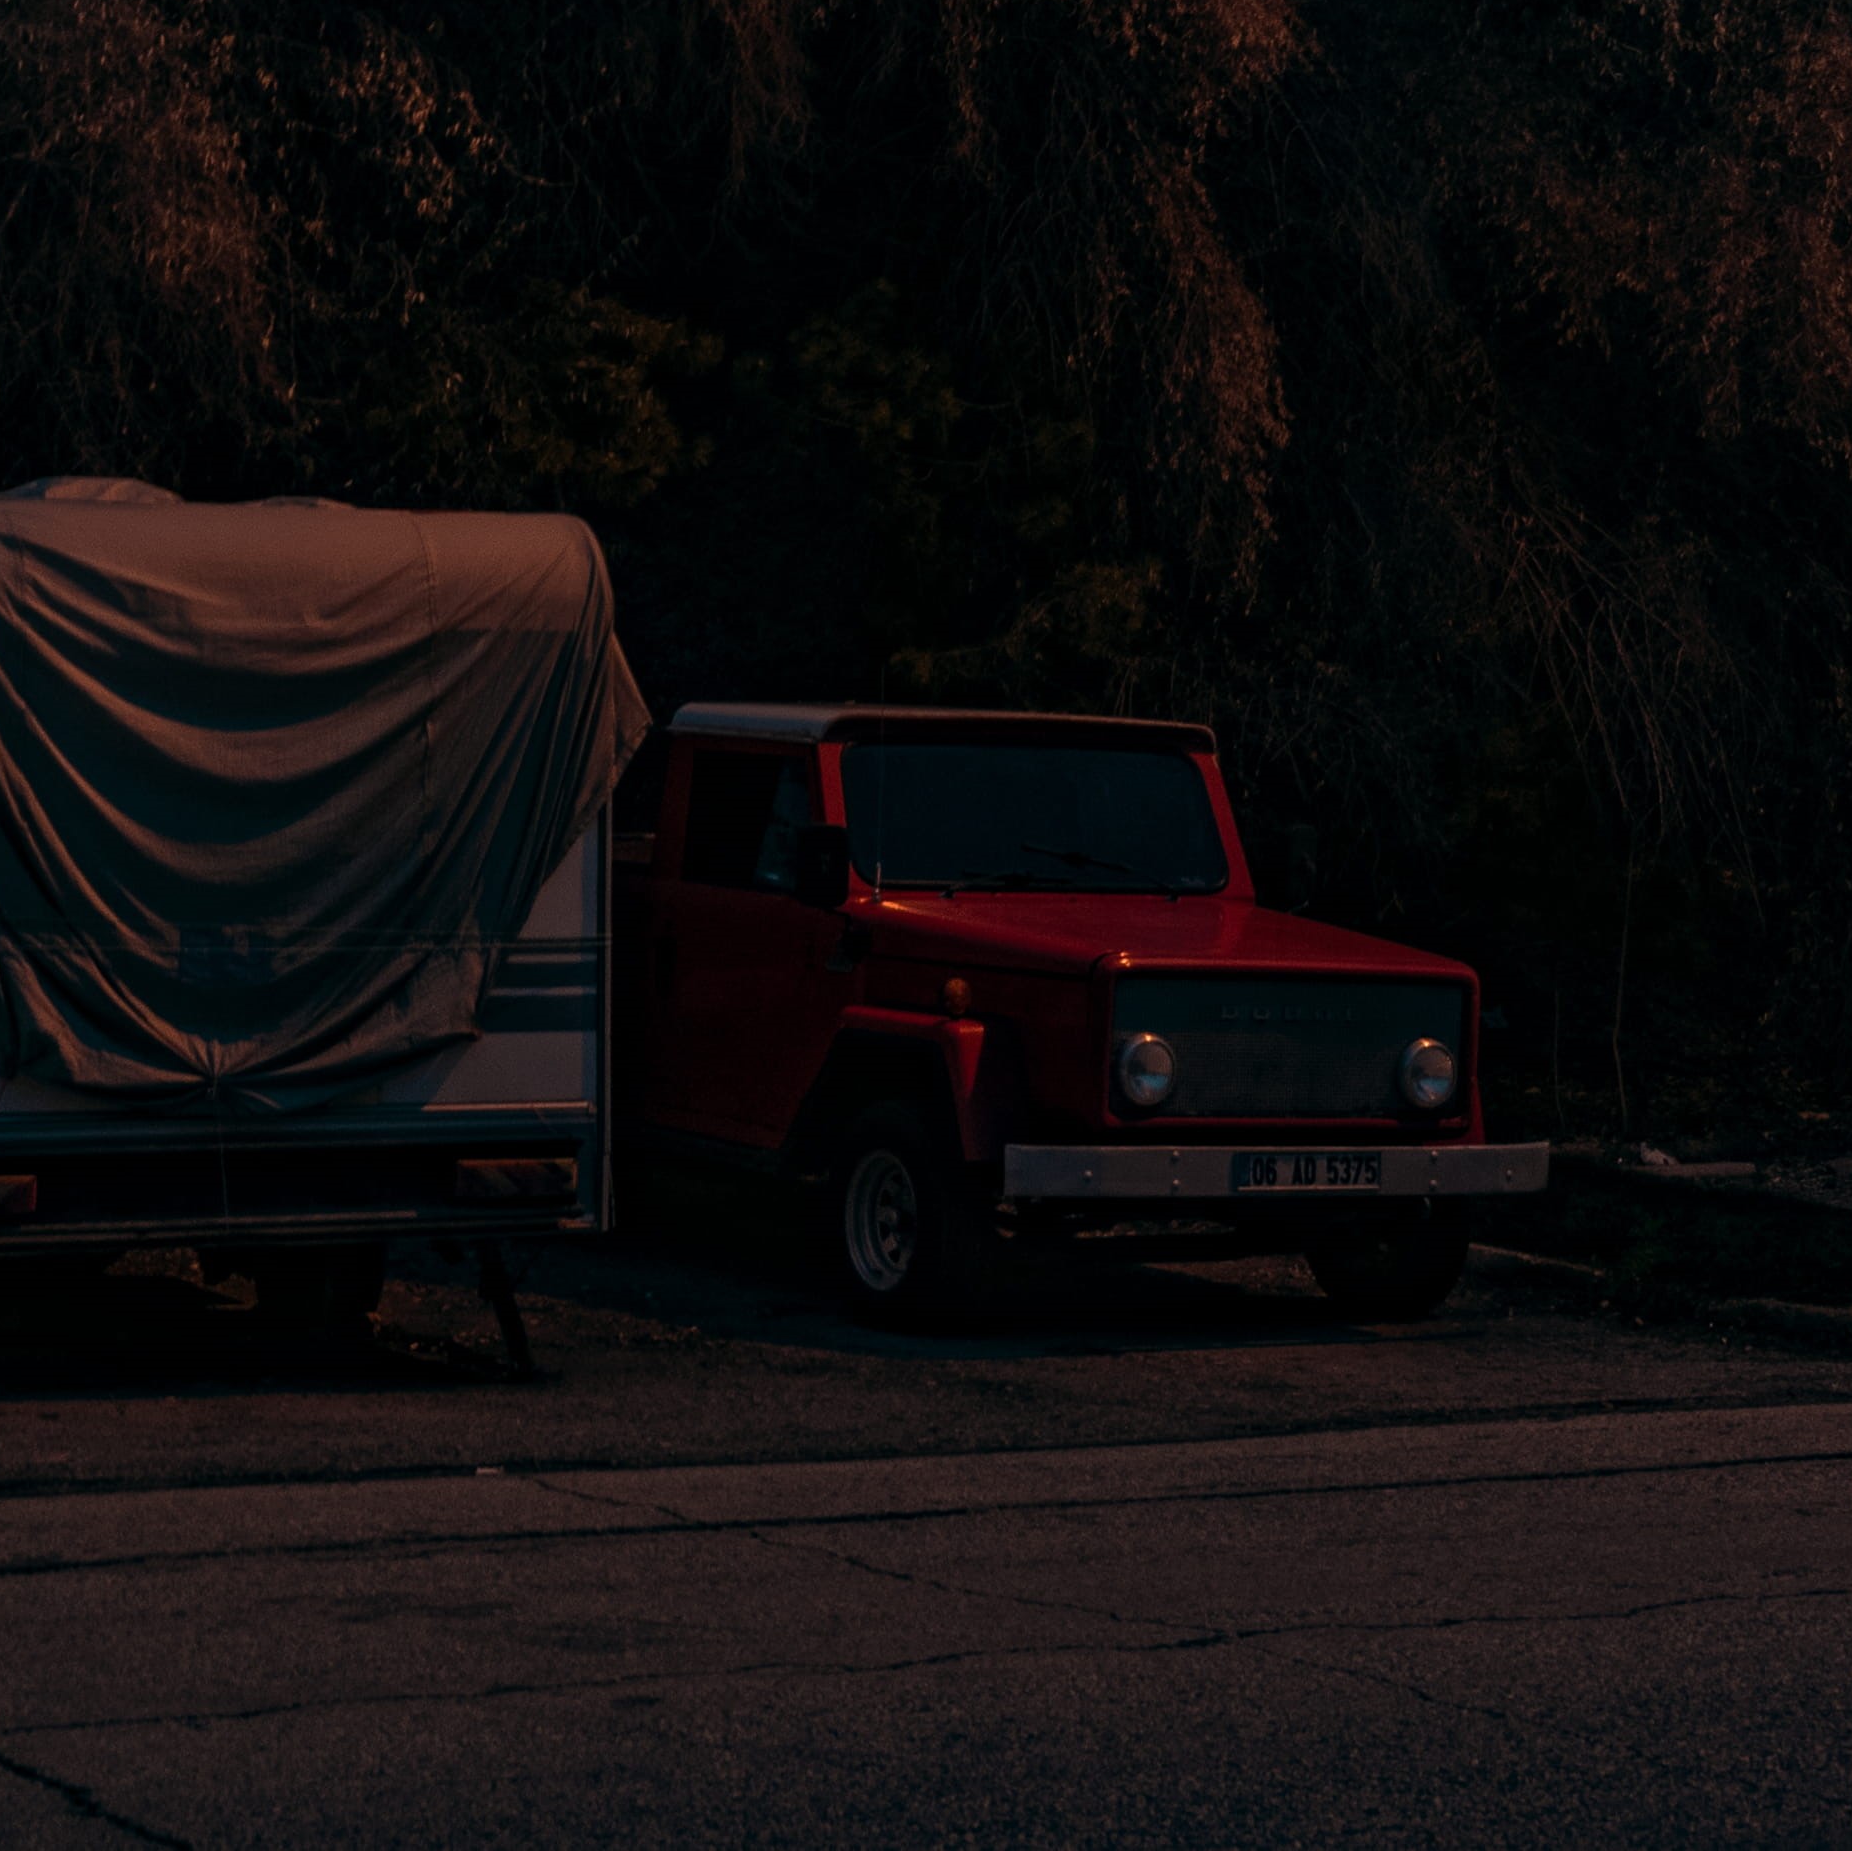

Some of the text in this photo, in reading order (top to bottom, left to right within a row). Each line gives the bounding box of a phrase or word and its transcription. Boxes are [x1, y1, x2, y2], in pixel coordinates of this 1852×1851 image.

[1253, 1156, 1377, 1185] 06 AD 5375
